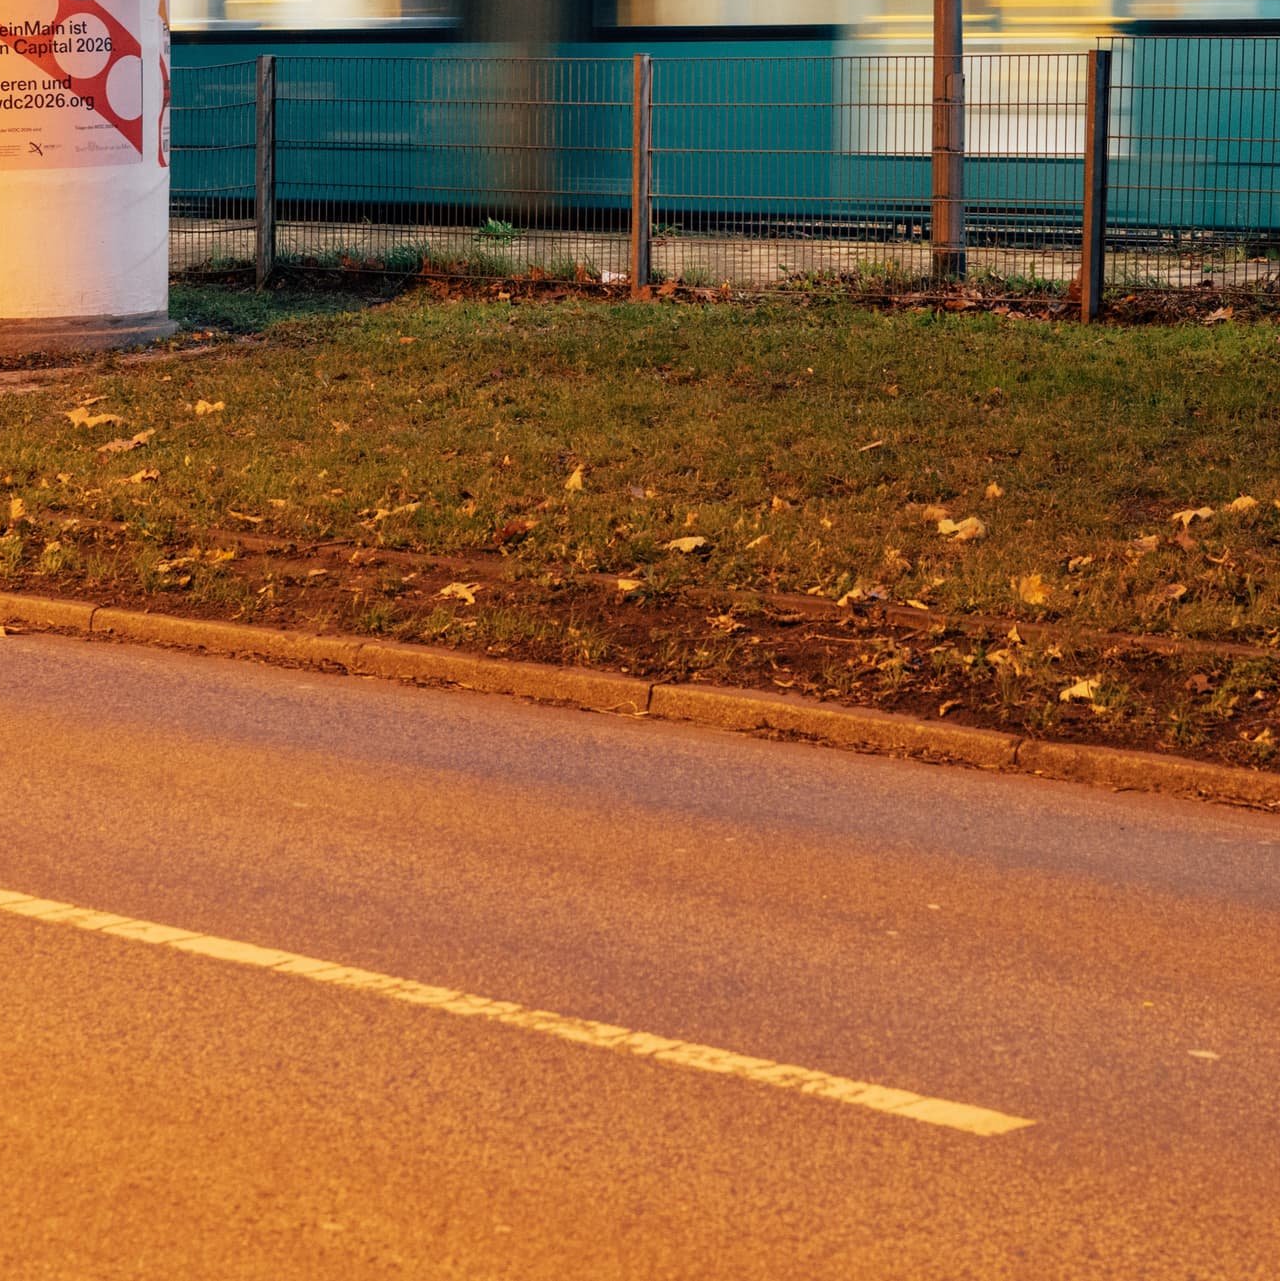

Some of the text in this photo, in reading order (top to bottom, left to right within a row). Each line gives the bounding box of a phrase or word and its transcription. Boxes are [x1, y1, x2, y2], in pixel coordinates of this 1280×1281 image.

[69, 21, 88, 35] ist
[13, 38, 72, 58] Capital
[76, 37, 117, 53] 2026.
[41, 74, 72, 90] und
